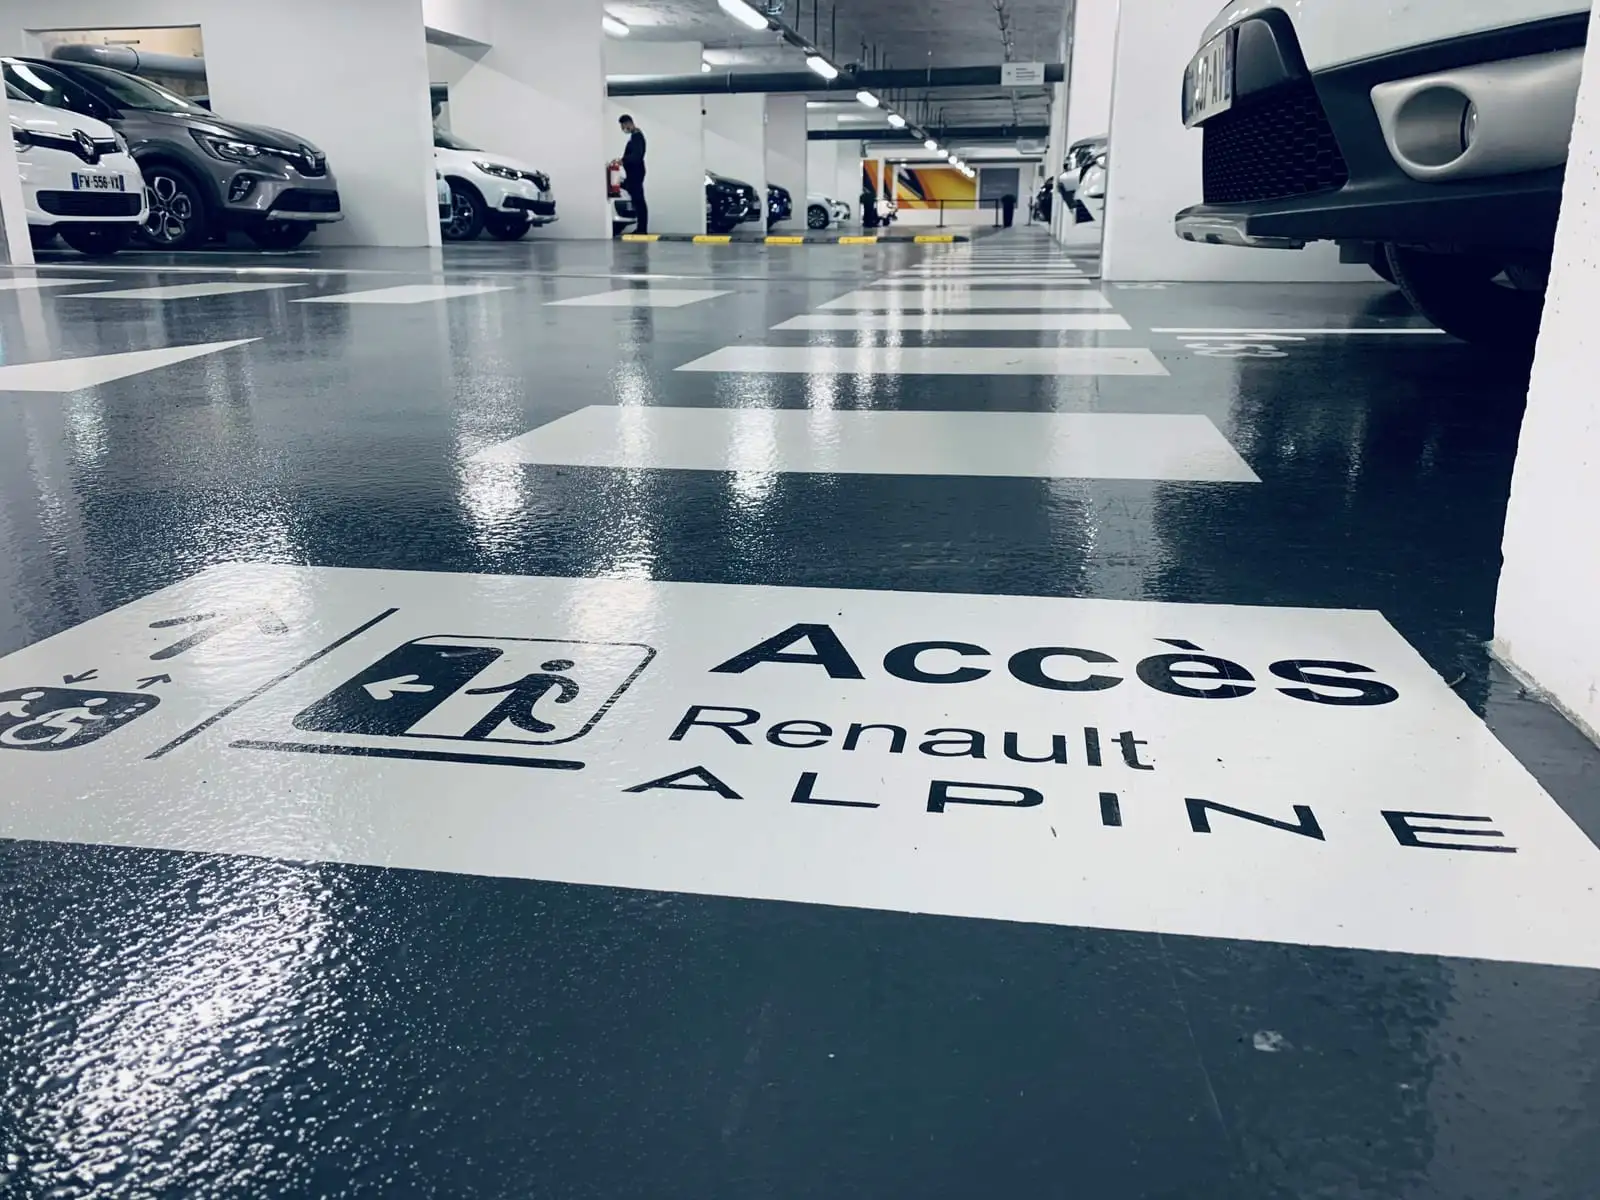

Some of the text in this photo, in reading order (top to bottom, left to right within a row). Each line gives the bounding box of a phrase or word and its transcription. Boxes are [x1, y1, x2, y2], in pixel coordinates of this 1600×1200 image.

[708, 623, 1399, 706] Accès
[668, 705, 1155, 770] Renault
[621, 765, 1517, 853] ALPINE
